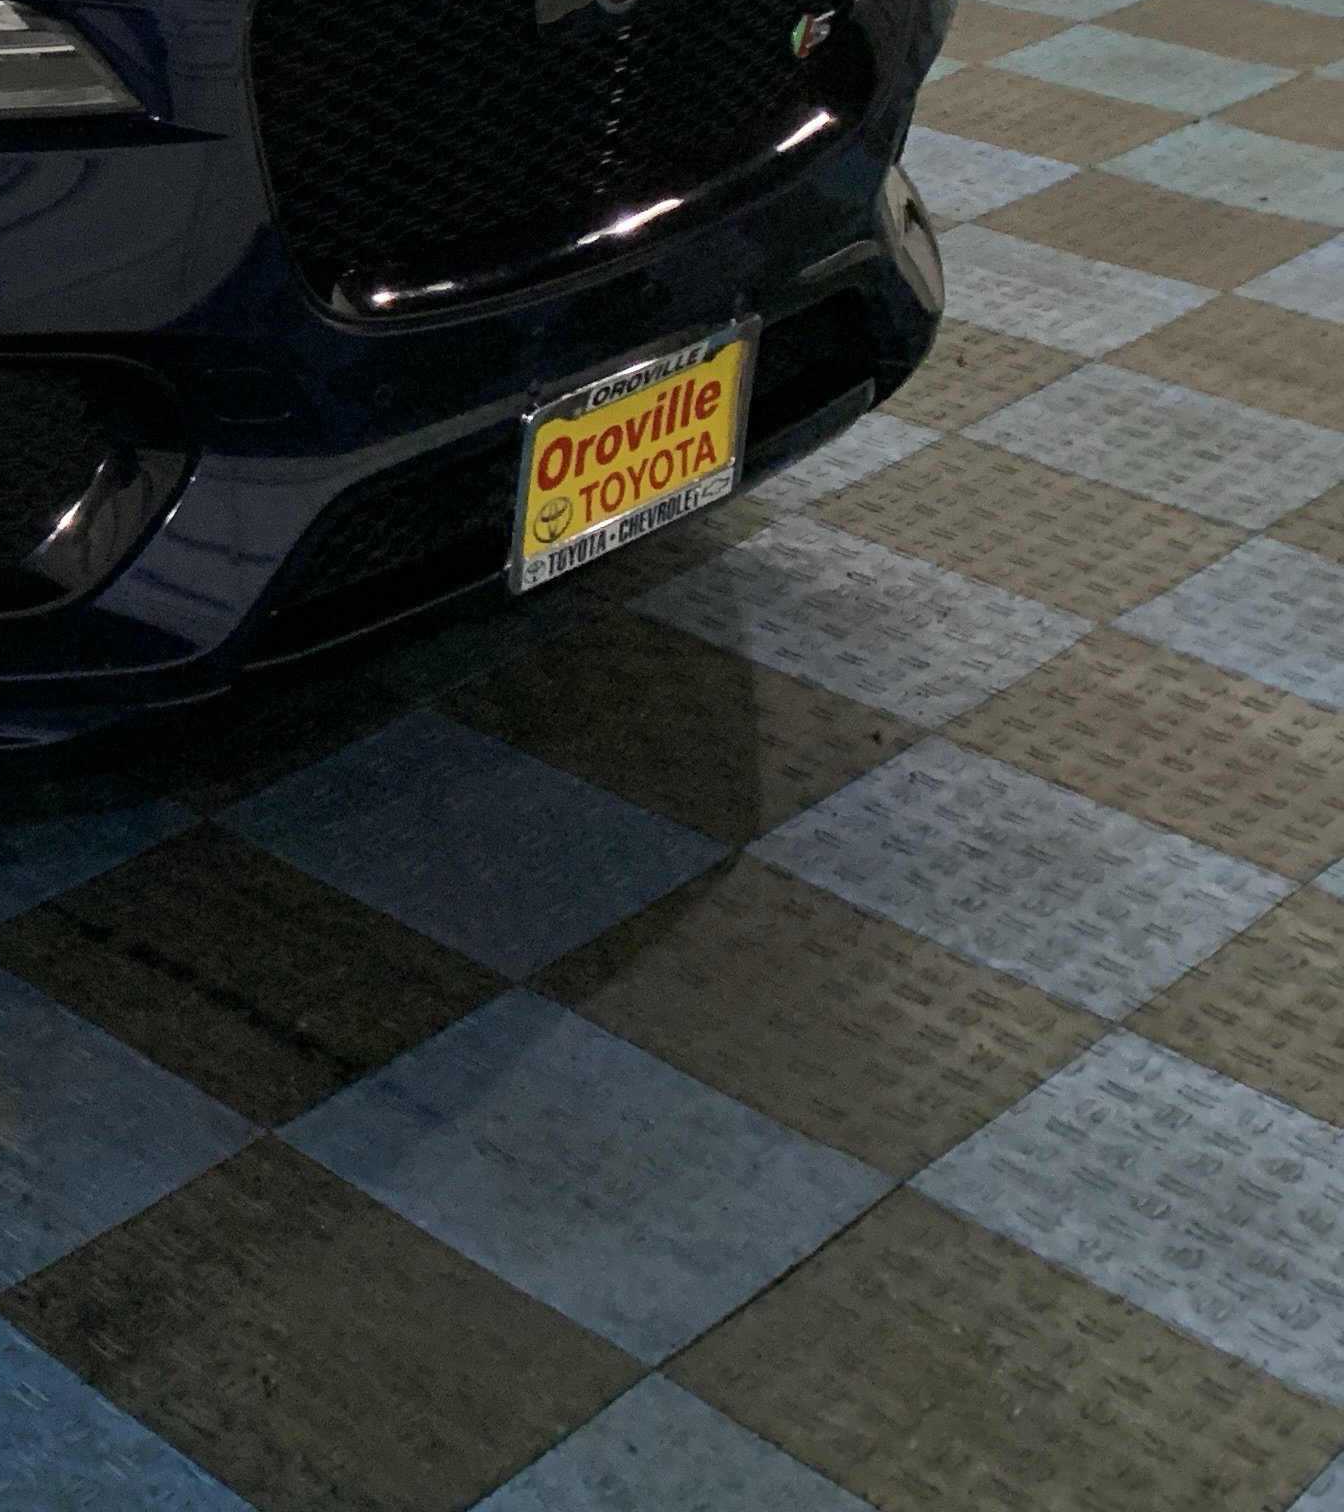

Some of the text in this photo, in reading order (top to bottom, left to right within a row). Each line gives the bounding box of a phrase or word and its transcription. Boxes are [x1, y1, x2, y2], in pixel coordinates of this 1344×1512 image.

[591, 346, 702, 406] OROVILLE
[536, 378, 722, 492] Oroville
[578, 430, 717, 523] TOYOTA
[547, 528, 607, 576] TOYOTA
